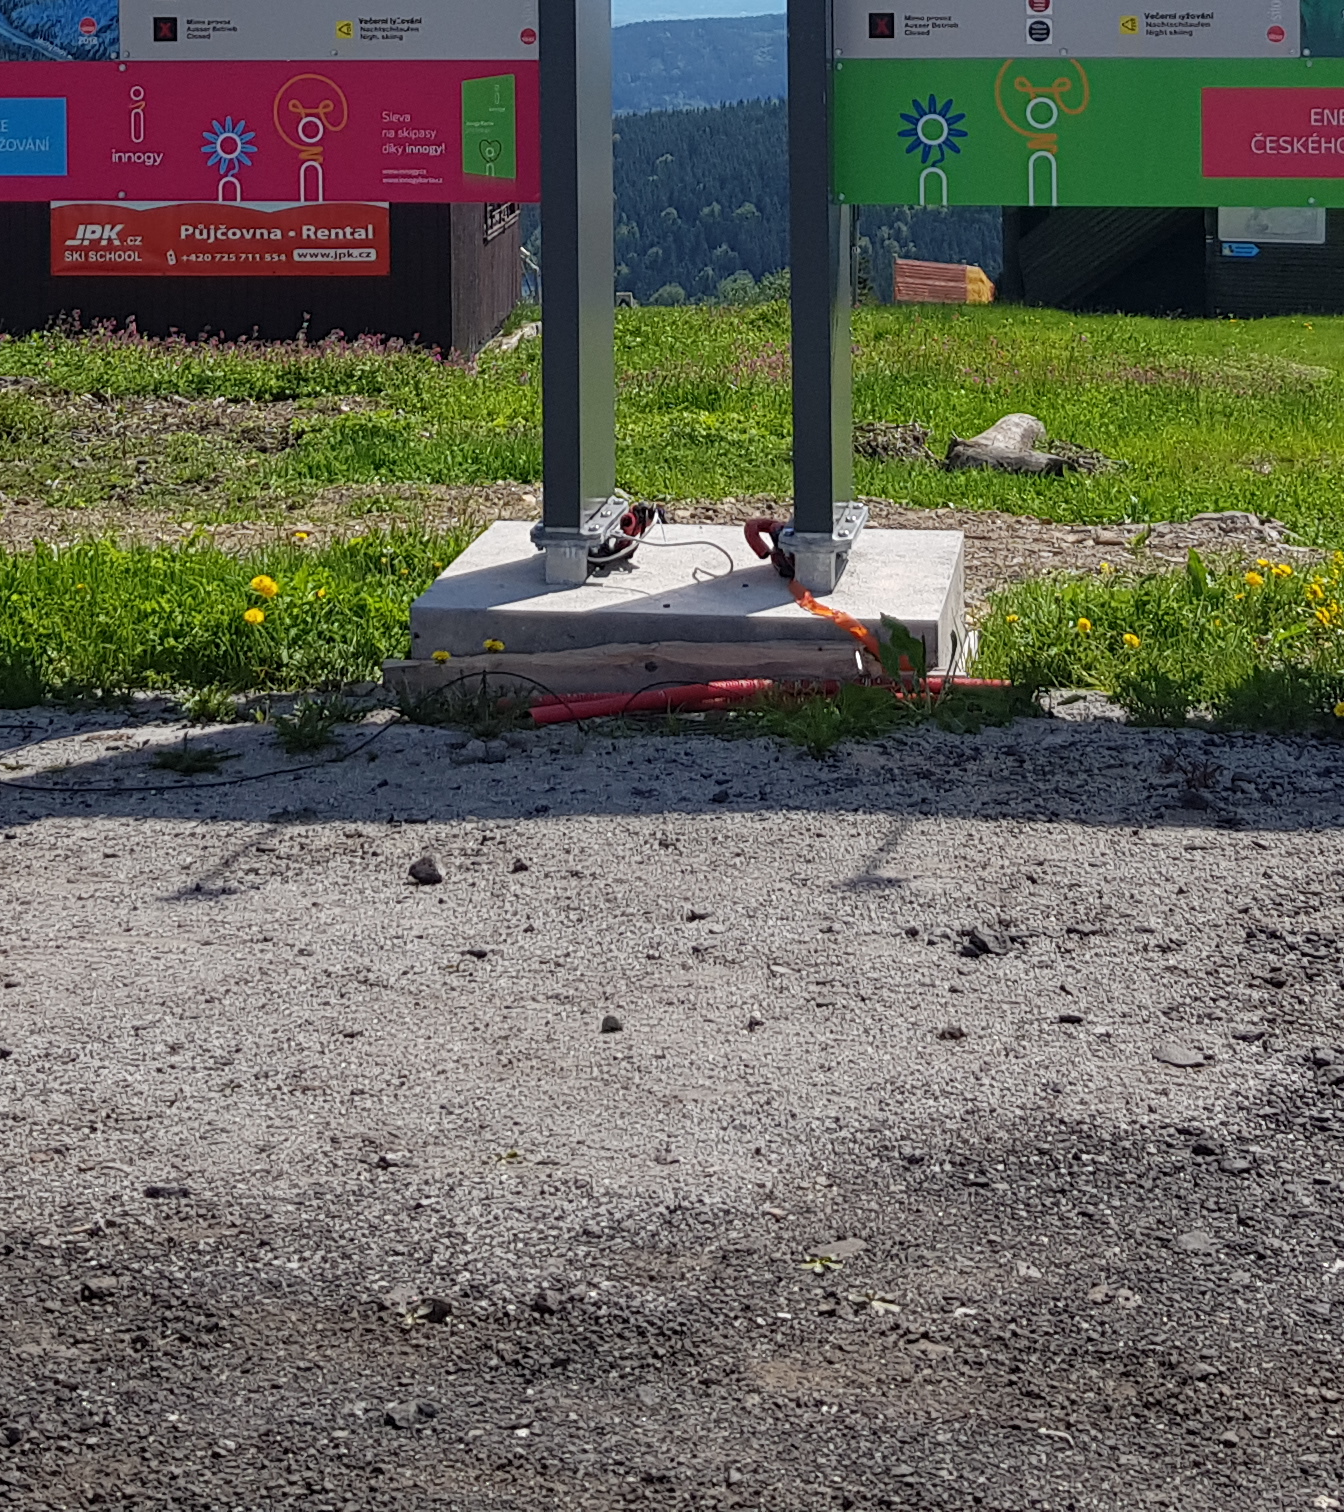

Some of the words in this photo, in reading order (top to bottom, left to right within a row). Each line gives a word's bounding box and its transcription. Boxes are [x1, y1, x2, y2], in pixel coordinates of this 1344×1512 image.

[381, 112, 412, 122] Sleva
[381, 129, 397, 137] na
[395, 128, 436, 139] skipasy
[406, 143, 445, 155] innogy!
[112, 150, 163, 165] innogy
[181, 225, 281, 242] Půjčovna
[302, 225, 373, 239] Rental
[65, 251, 86, 261] SKI
[89, 251, 142, 261] SCHOOL
[297, 249, 372, 261] www.jpk.cz
